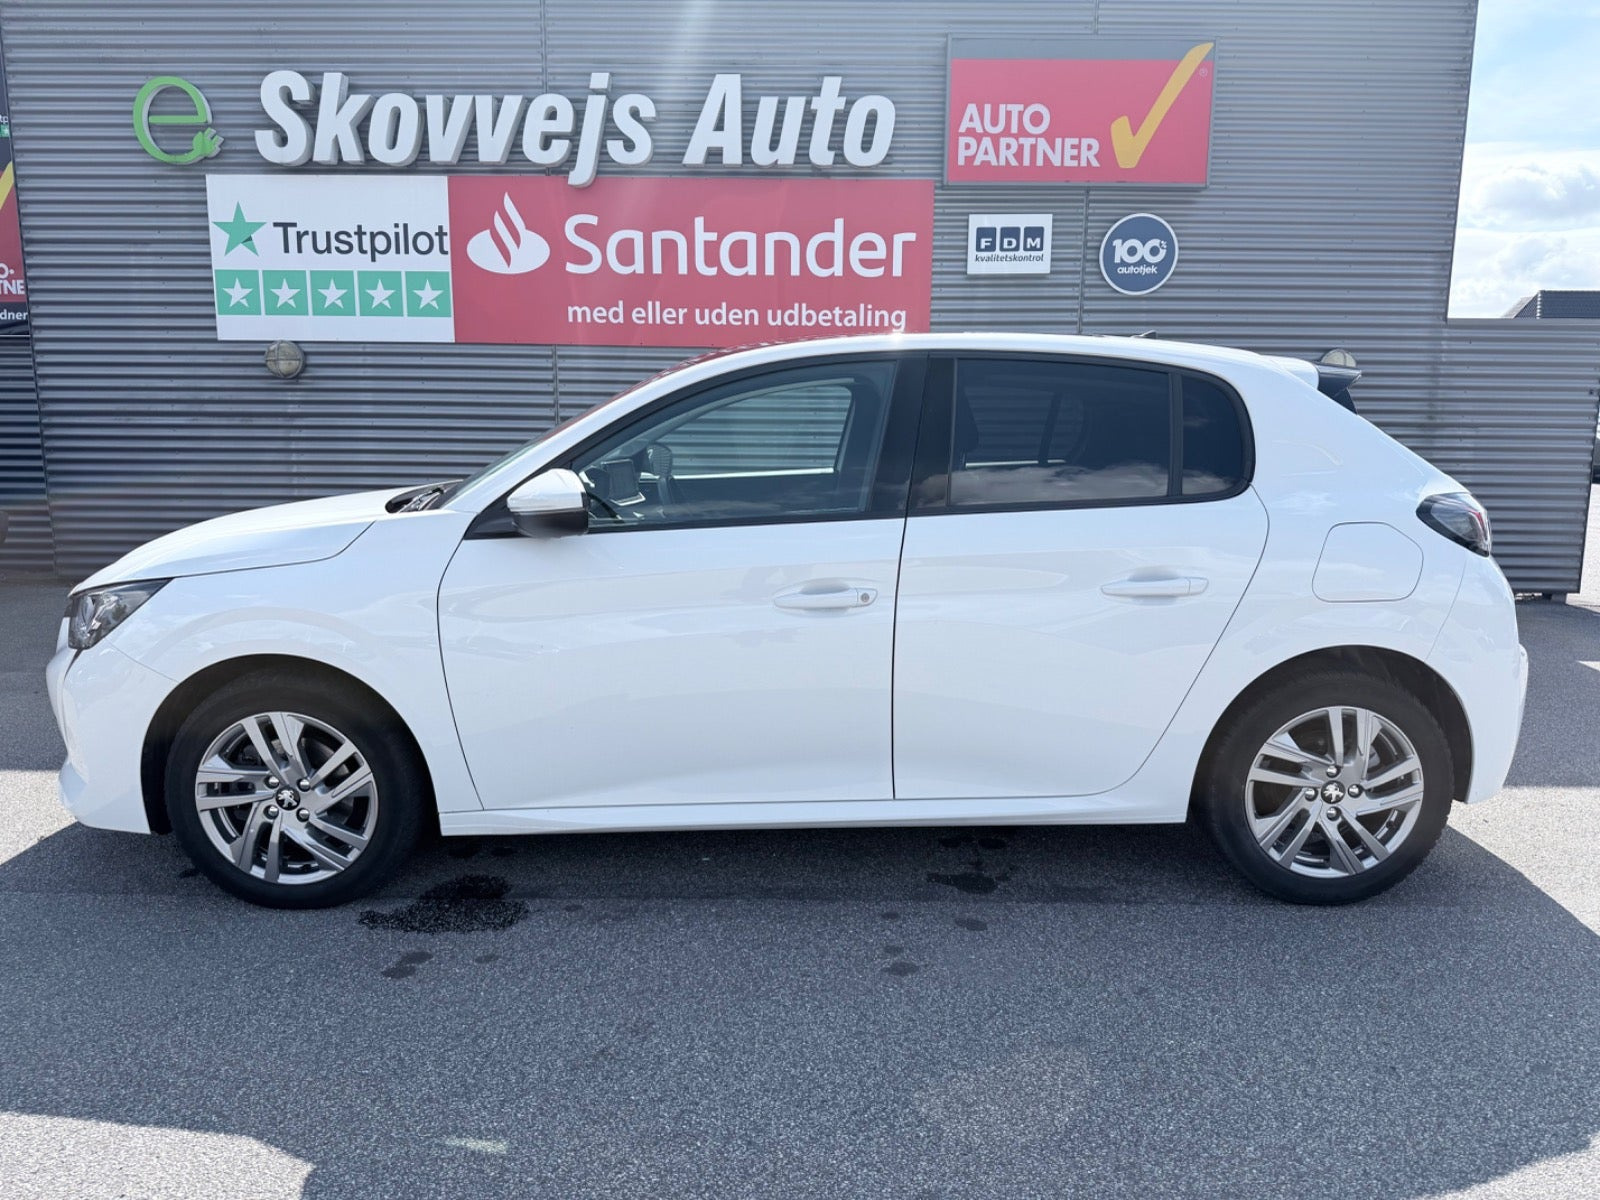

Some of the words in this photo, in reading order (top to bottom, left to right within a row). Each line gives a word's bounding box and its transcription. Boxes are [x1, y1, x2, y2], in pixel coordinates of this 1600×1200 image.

[254, 69, 657, 188] Skovvejs
[681, 73, 897, 169] Auto
[958, 103, 1050, 135] AUTO
[957, 136, 1101, 168] PARTNER
[273, 221, 449, 262] Trustpilot
[564, 213, 917, 278] Santander
[980, 237, 1041, 250] FDM
[975, 254, 1044, 263] kvalitetskontrol
[1117, 264, 1158, 275] autotjek
[567, 301, 624, 324] med
[631, 301, 688, 325] eller
[695, 303, 760, 326] uden
[767, 303, 907, 331] udbetaling
